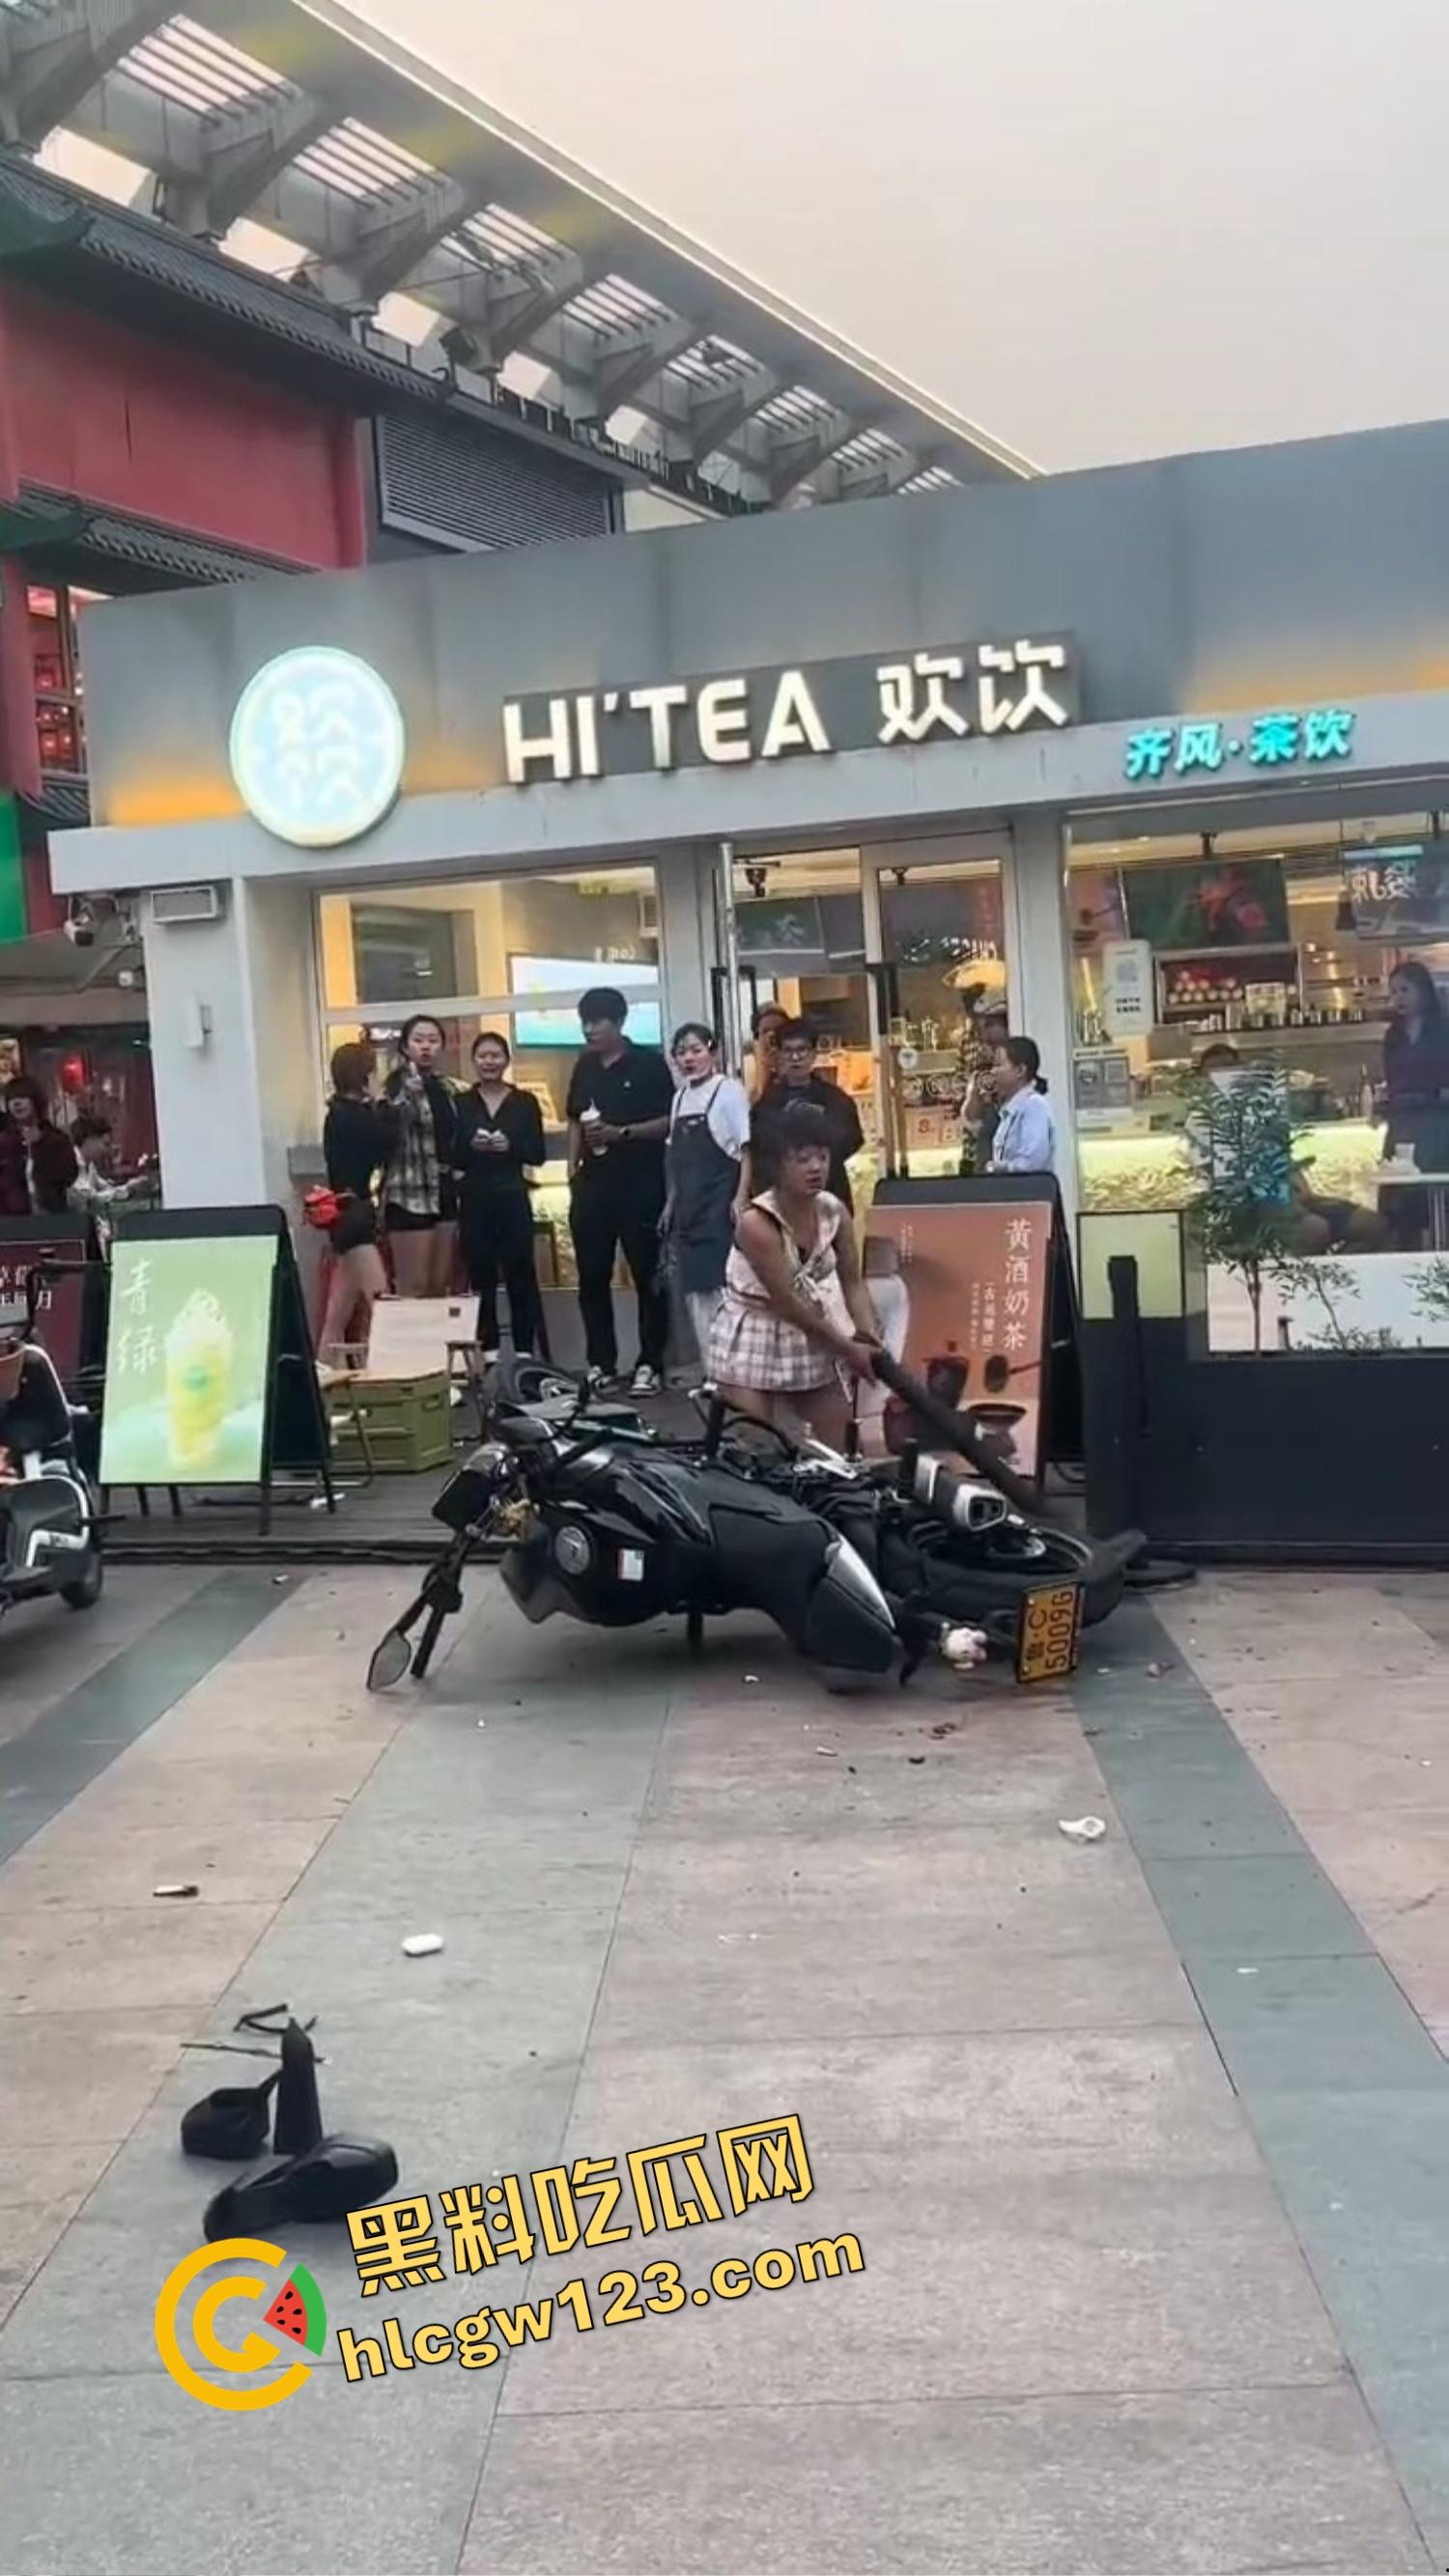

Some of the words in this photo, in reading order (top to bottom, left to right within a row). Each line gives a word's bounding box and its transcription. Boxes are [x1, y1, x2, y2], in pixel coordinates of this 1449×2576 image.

[502, 669, 832, 784] HI'TEA
[876, 639, 1069, 745] 欢饮
[1003, 1218, 1035, 1351] 黄酒奶茶
[1045, 1591, 1073, 1670] 50096
